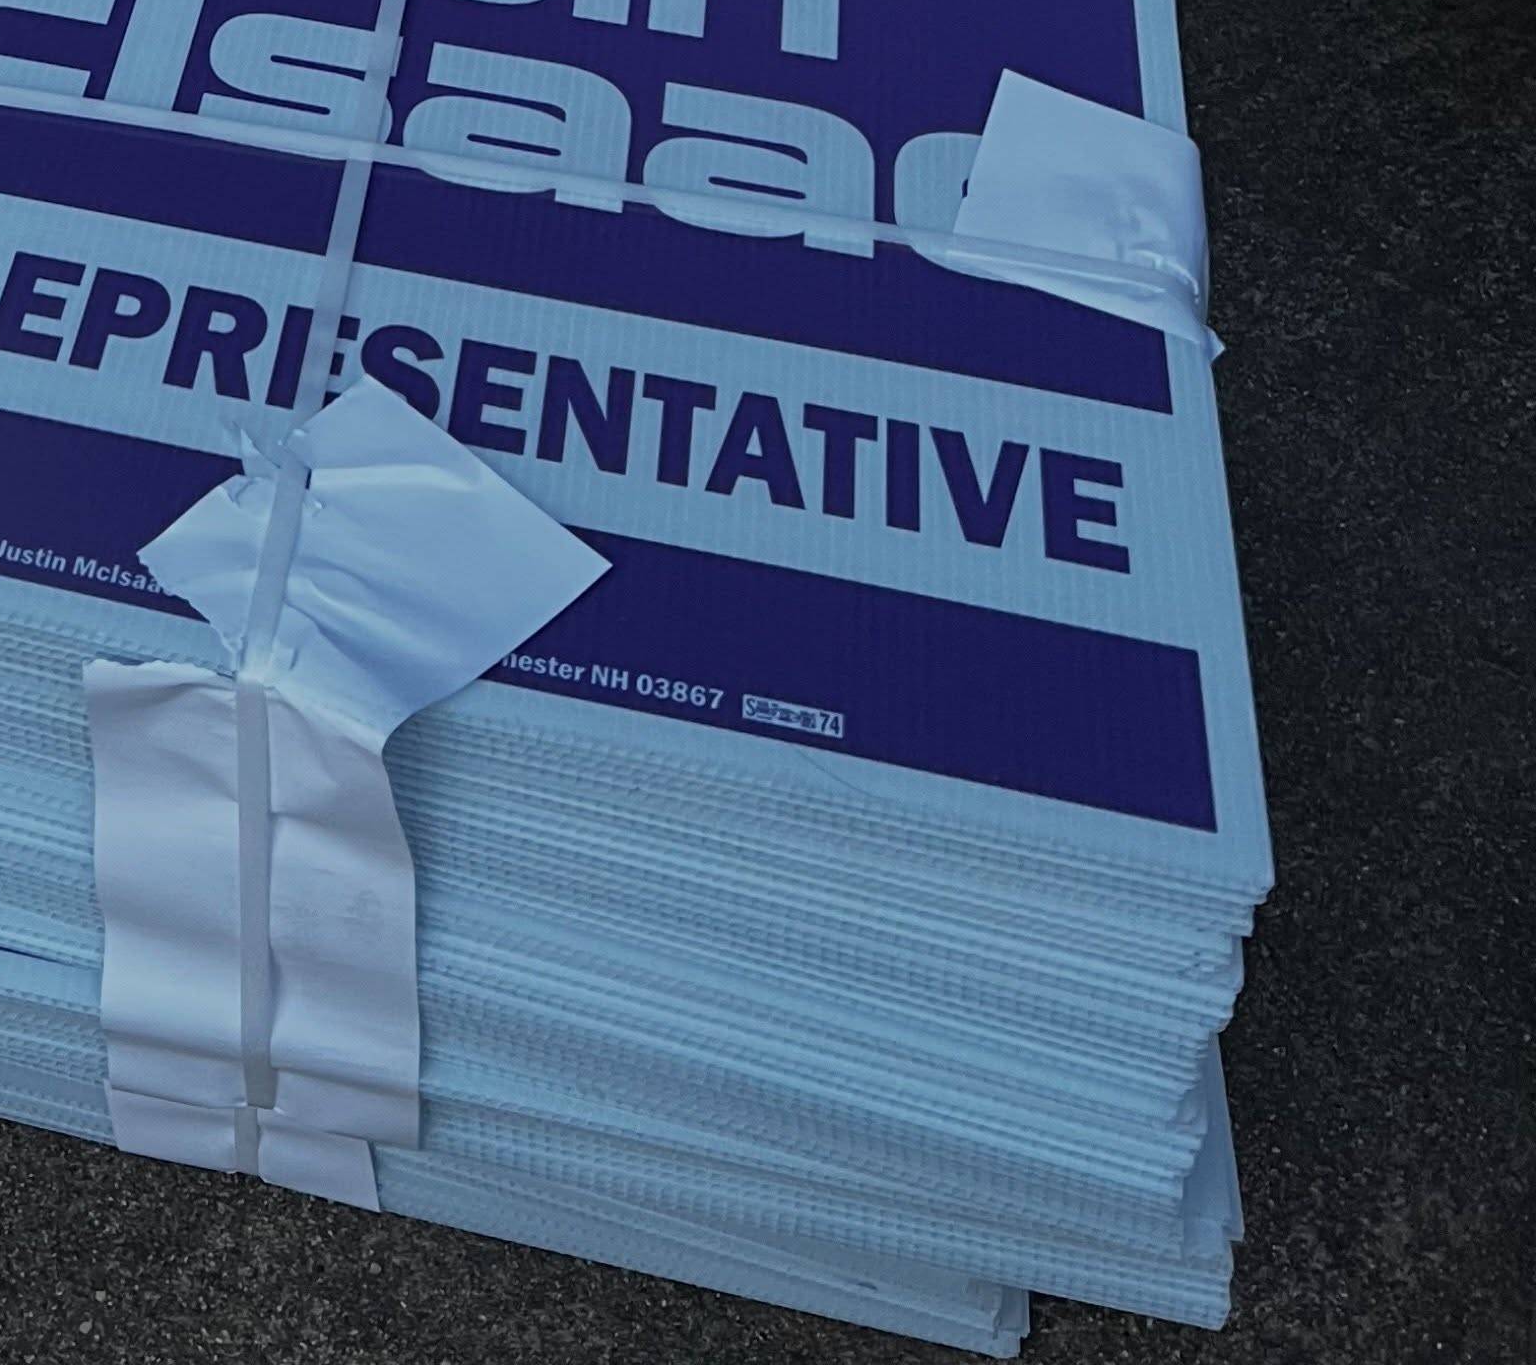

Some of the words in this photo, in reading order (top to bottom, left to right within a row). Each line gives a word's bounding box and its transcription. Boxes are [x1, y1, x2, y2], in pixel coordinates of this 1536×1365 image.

[590, 663, 630, 693] NH
[635, 672, 726, 711] 03867
[818, 712, 840, 736] 74
